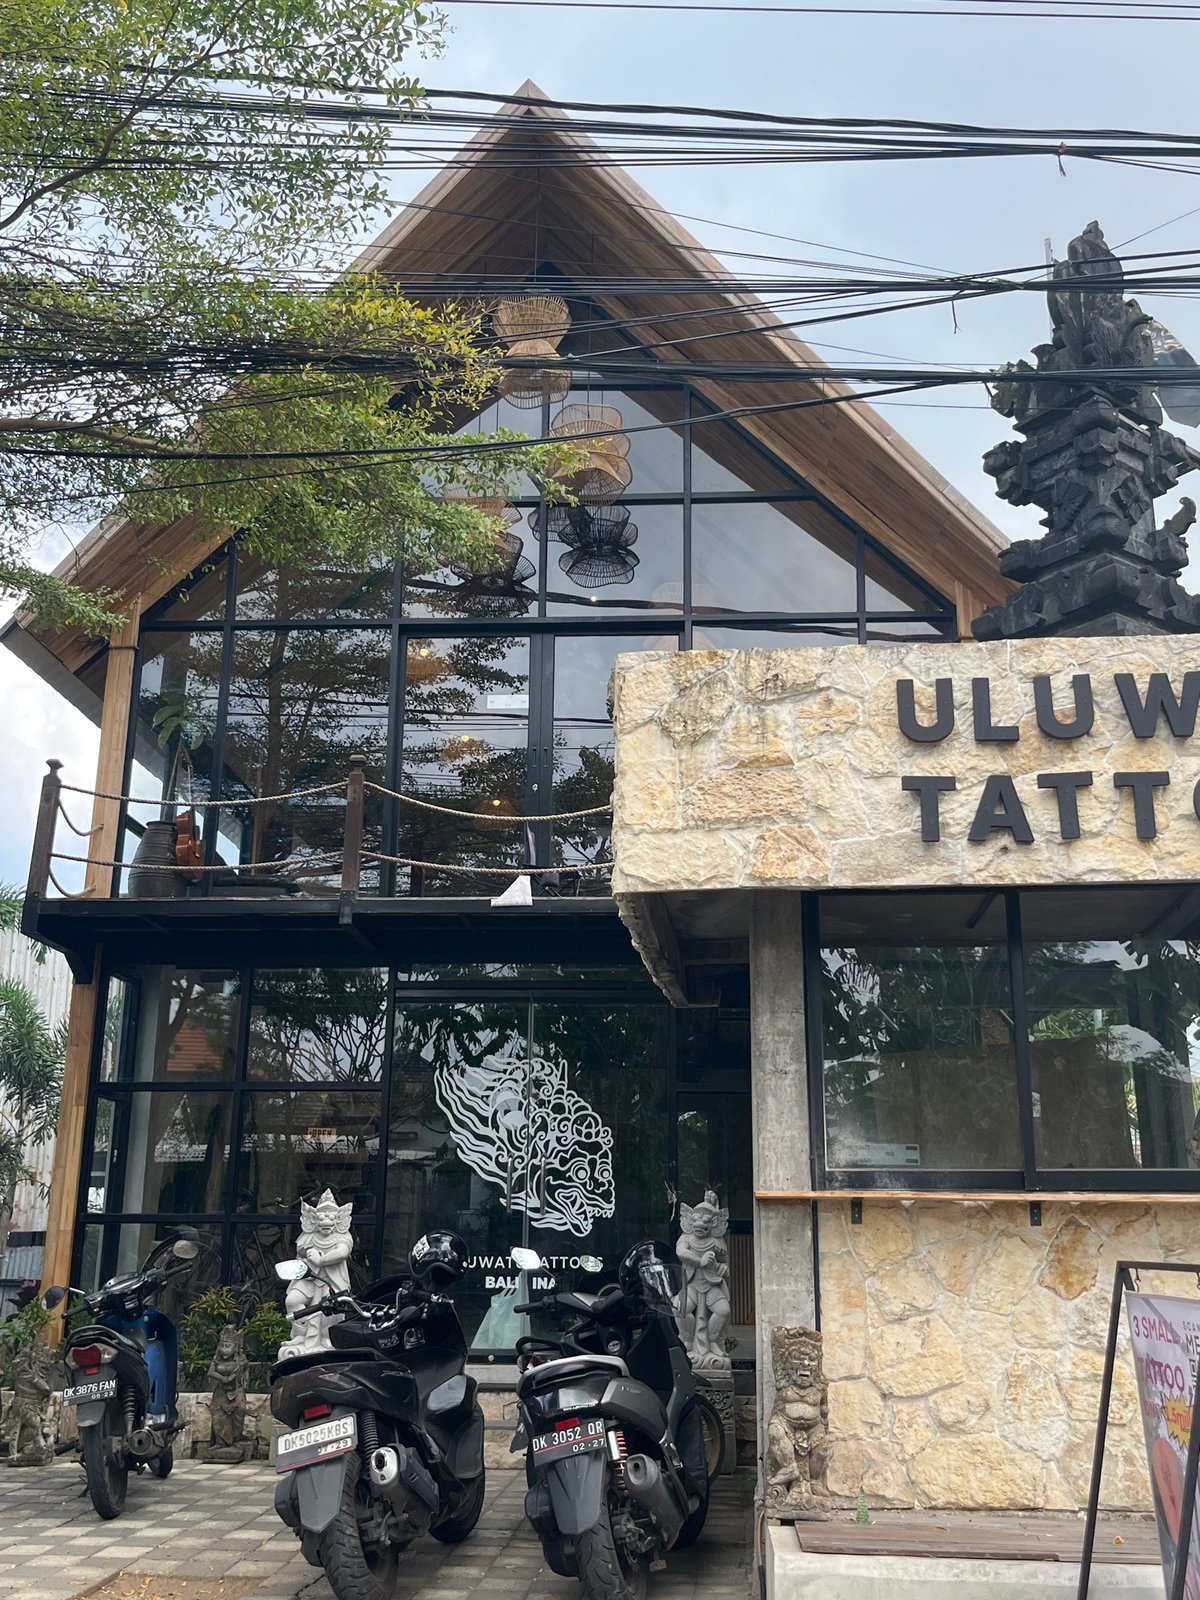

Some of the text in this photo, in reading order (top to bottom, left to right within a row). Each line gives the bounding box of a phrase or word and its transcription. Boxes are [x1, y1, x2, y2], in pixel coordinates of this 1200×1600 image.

[901, 771, 1200, 843] TATT
[1133, 1315, 1179, 1345] 3 SMALL
[63, 1380, 116, 1398] DK 3876 FAN
[1137, 1357, 1185, 1392] TATTOO
[532, 1435, 548, 1452] DK
[552, 1427, 582, 1445] 3052
